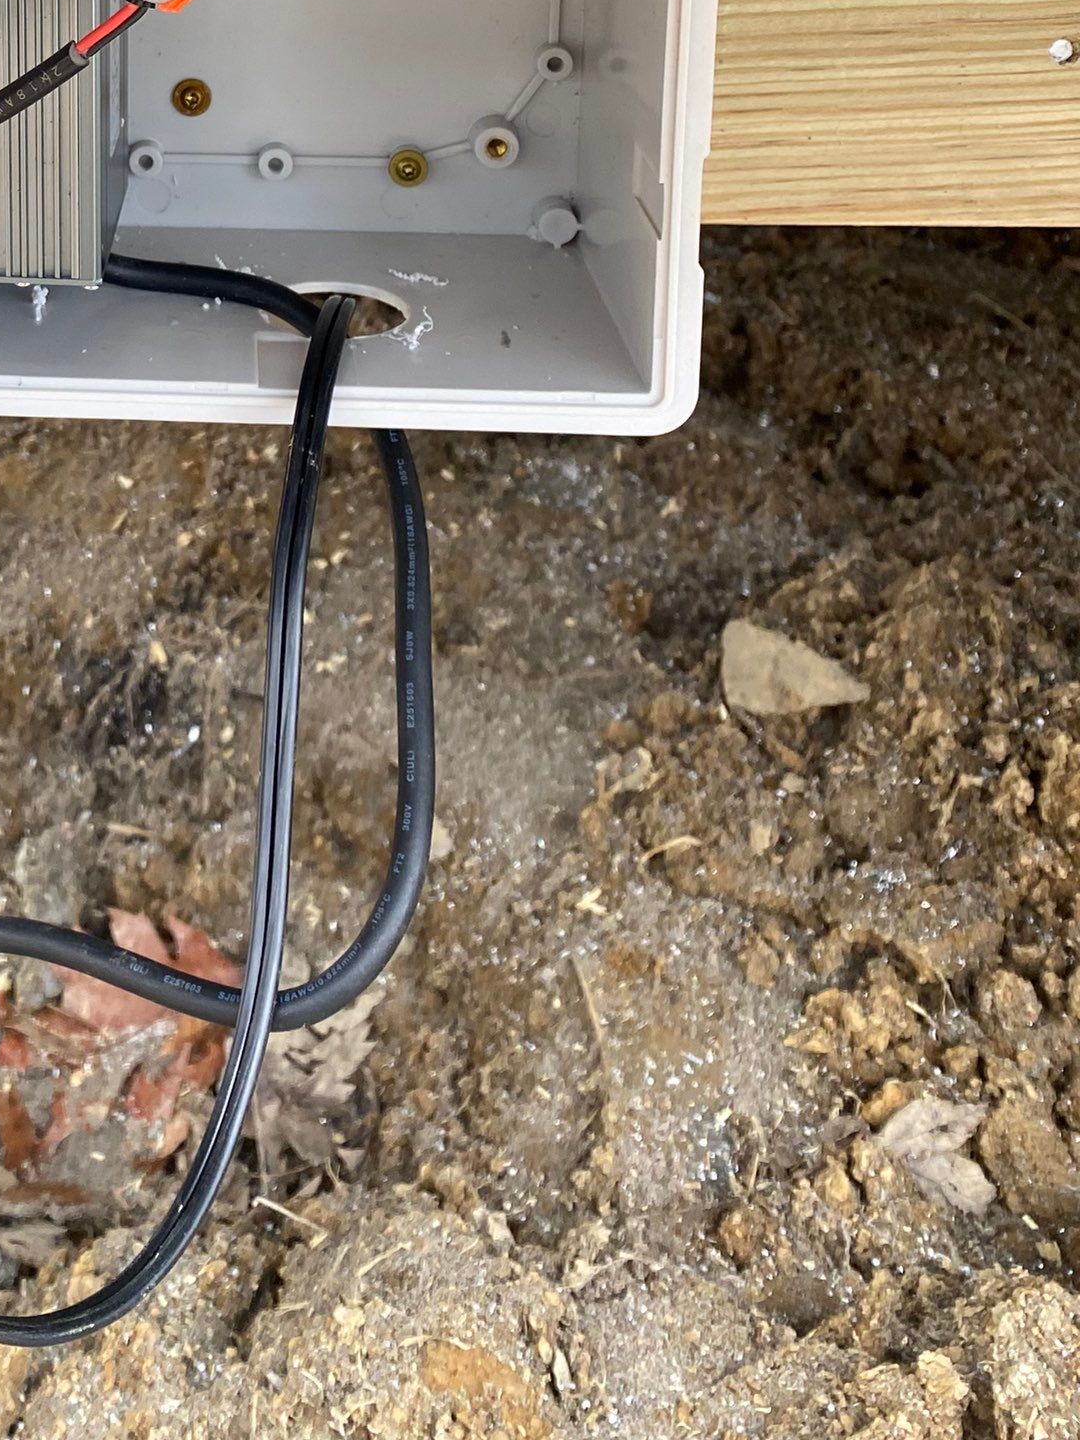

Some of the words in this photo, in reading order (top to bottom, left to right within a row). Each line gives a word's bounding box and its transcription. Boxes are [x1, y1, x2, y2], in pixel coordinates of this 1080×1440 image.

[397, 458, 408, 487] 105°C
[406, 682, 415, 728] E251603
[402, 804, 412, 831] 300V
[393, 852, 405, 873] FT2
